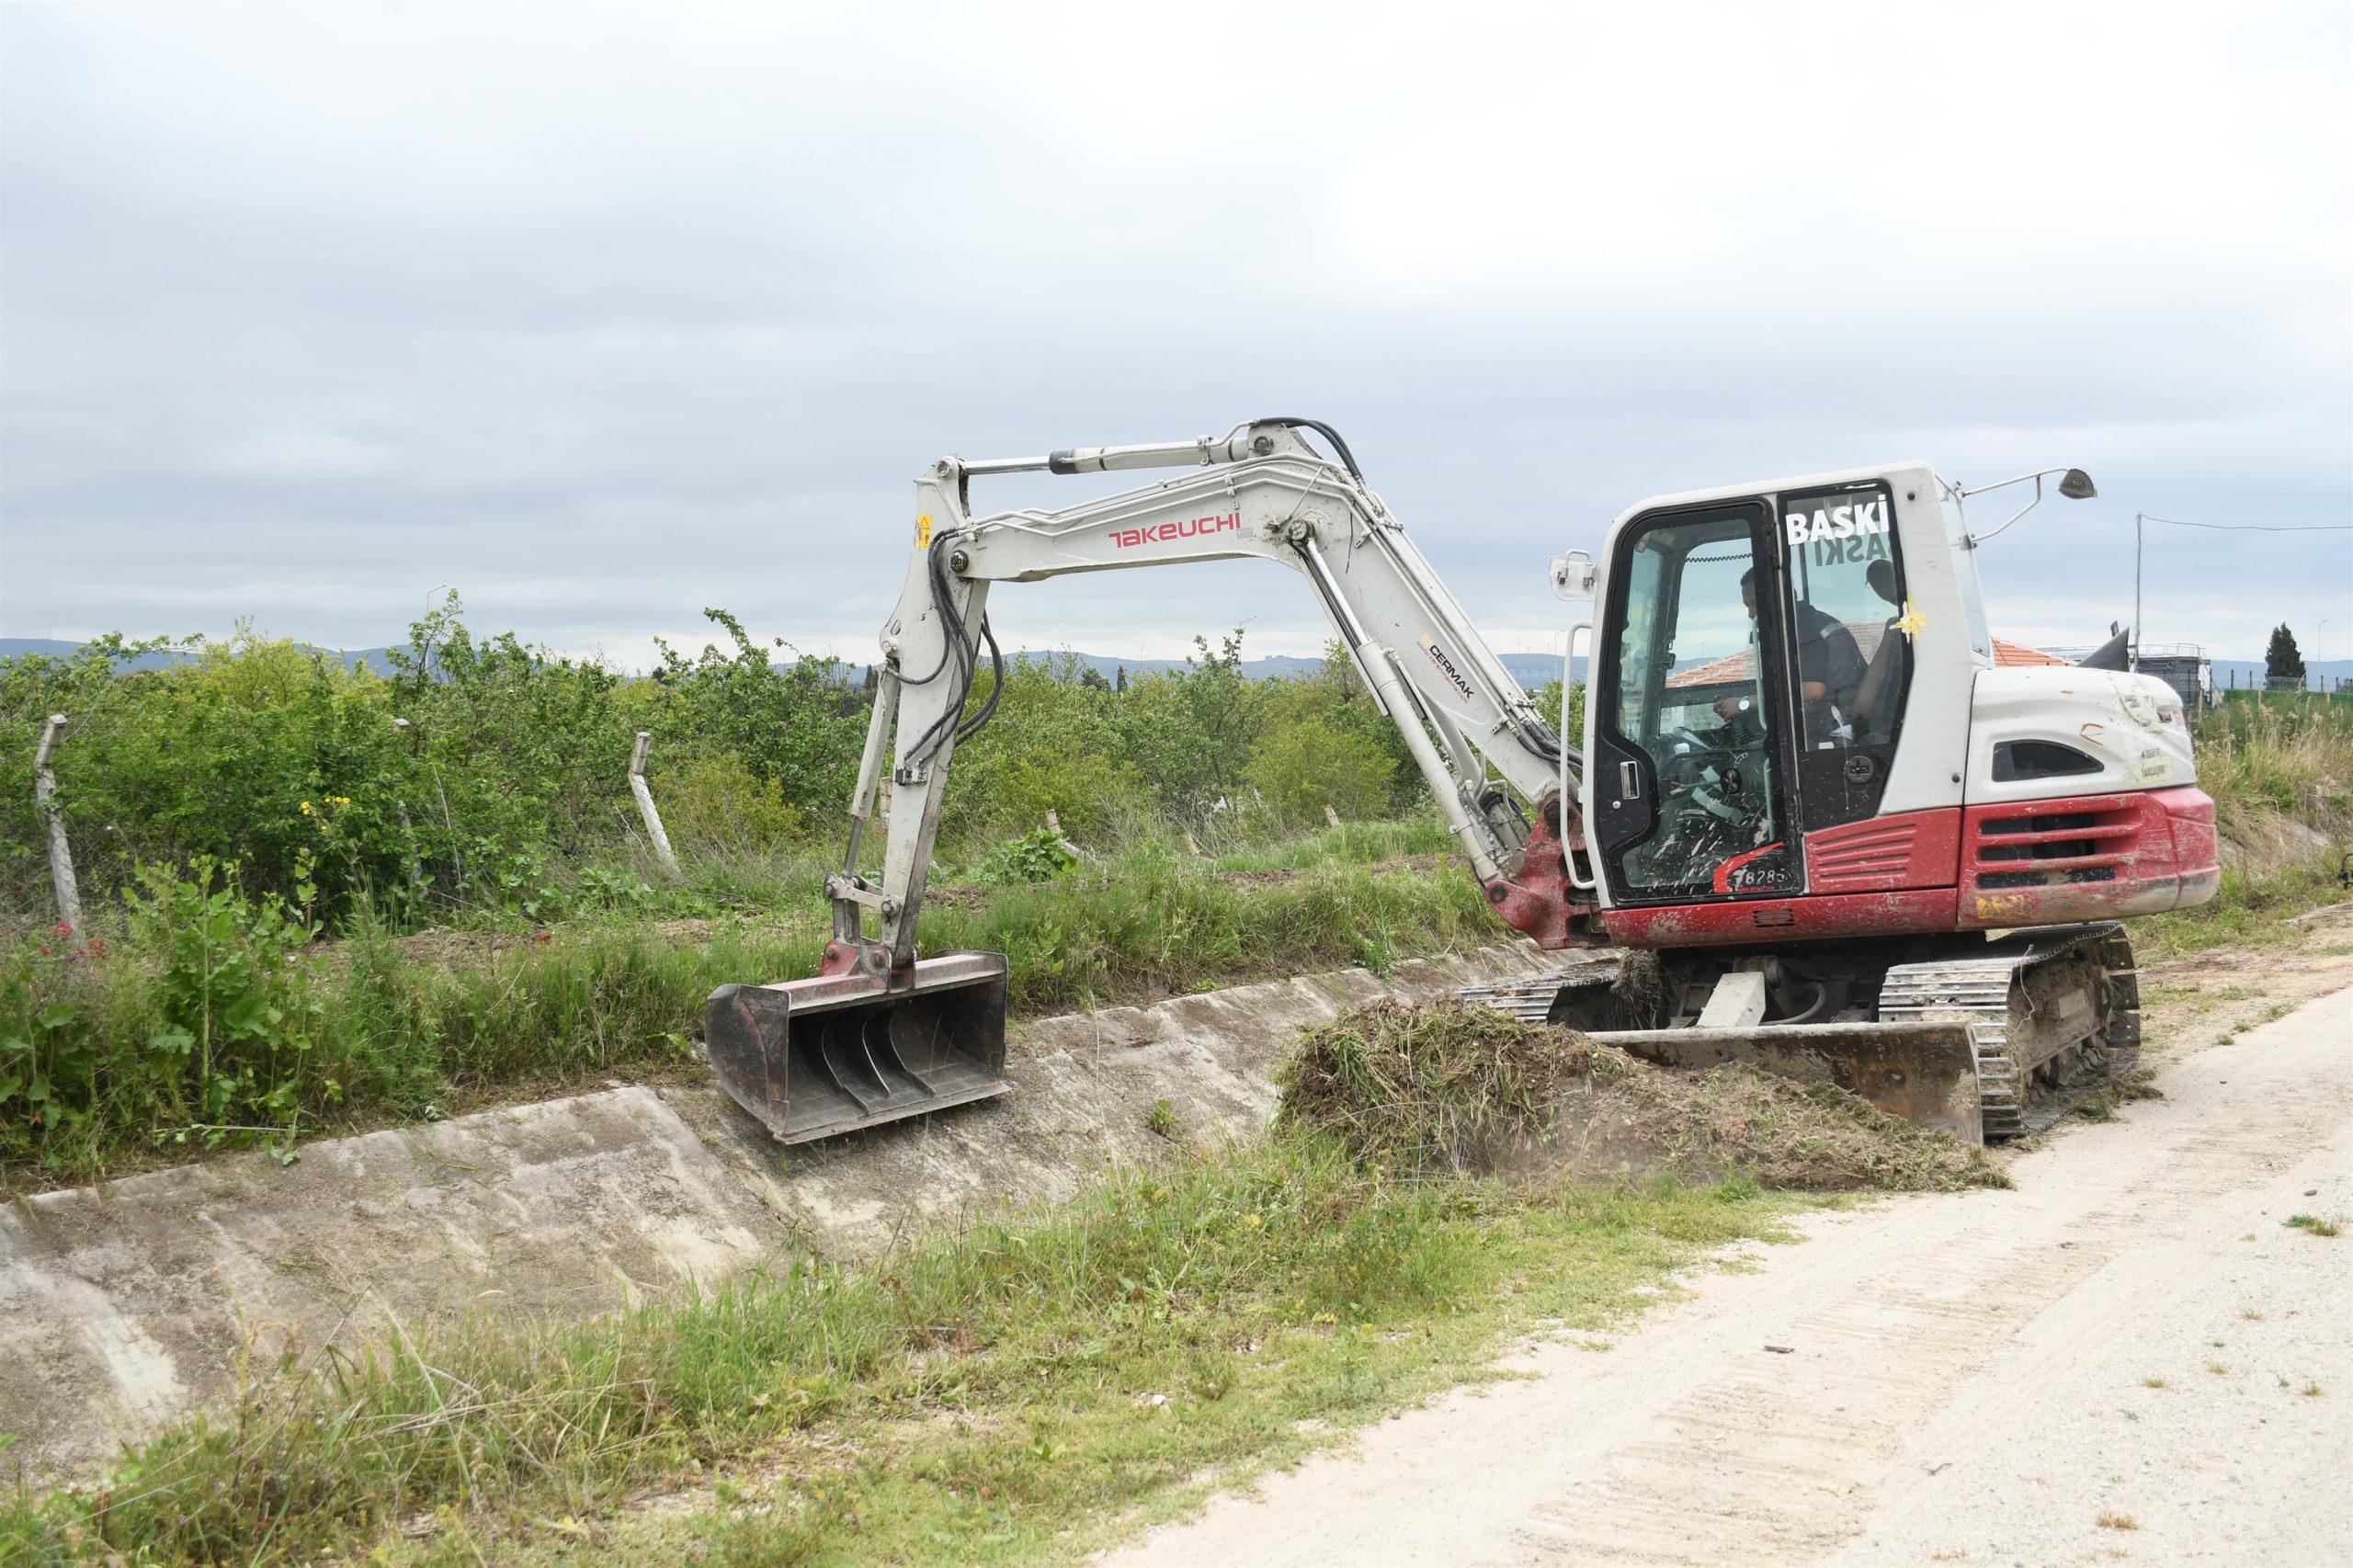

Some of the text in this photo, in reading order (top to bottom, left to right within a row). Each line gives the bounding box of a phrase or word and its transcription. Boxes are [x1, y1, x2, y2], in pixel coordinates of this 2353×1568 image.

[1108, 512, 1241, 548] TAKEUCHI
[1785, 494, 1890, 545] BASKİ
[1429, 644, 1474, 699] CERMAK
